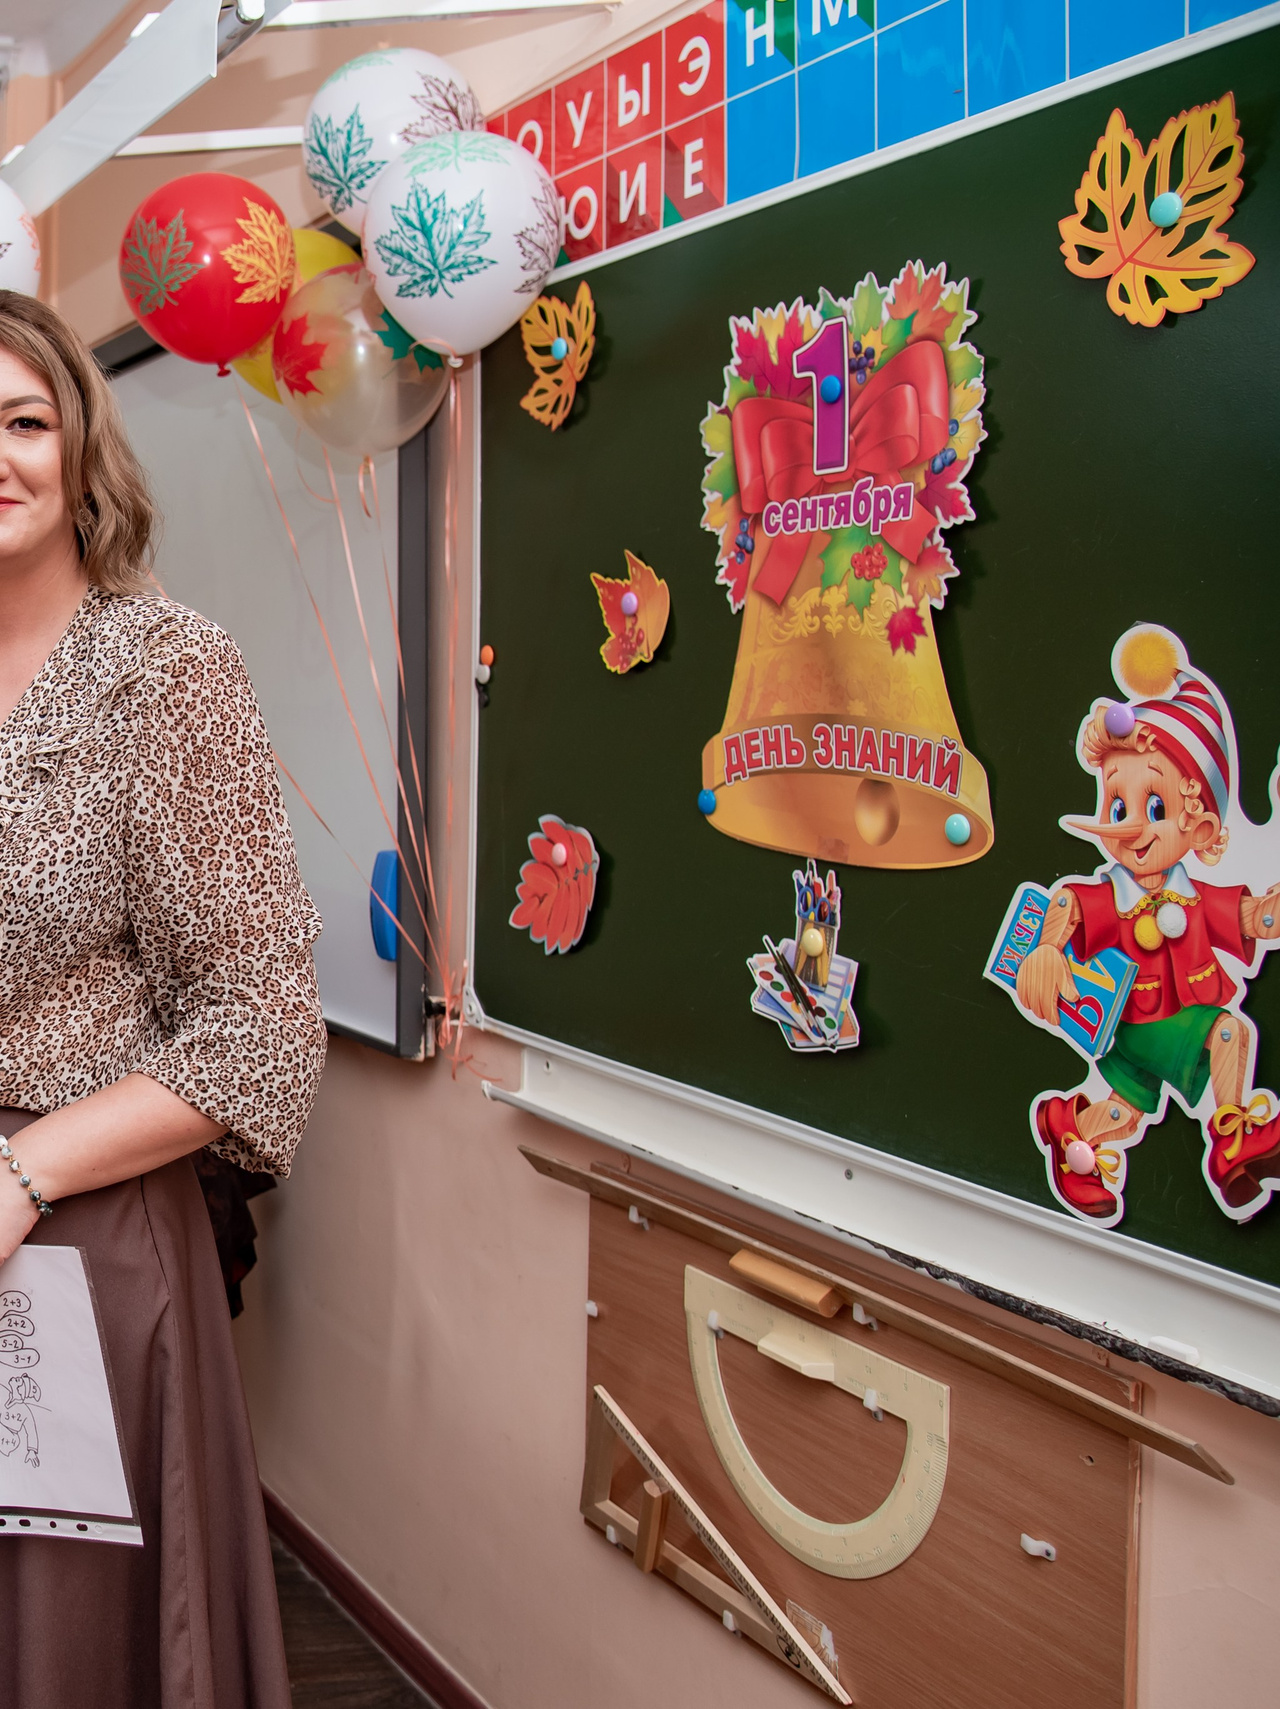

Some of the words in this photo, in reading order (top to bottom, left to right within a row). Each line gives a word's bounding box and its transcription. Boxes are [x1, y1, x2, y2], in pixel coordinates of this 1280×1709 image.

[566, 90, 593, 149] У
[617, 61, 650, 128] Ы
[677, 35, 711, 96] Э
[745, 0, 775, 68] Н
[558, 185, 598, 247] Ю
[619, 161, 647, 224] И
[683, 137, 704, 199] Е
[793, 319, 849, 475] 1
[763, 477, 914, 537] сентября
[722, 724, 807, 786] ДЕНЬ
[812, 722, 963, 799] ЗНАНИЙ
[995, 896, 1046, 979] АЗБУКА
[2, 1297, 22, 1308] 2+3
[7, 1318, 26, 1328] 2+2
[1, 1339, 19, 1348] 5-2
[14, 1354, 31, 1364] 3-1
[32, 1385, 38, 1394] 5
[4, 1412, 22, 1422] 3+2
